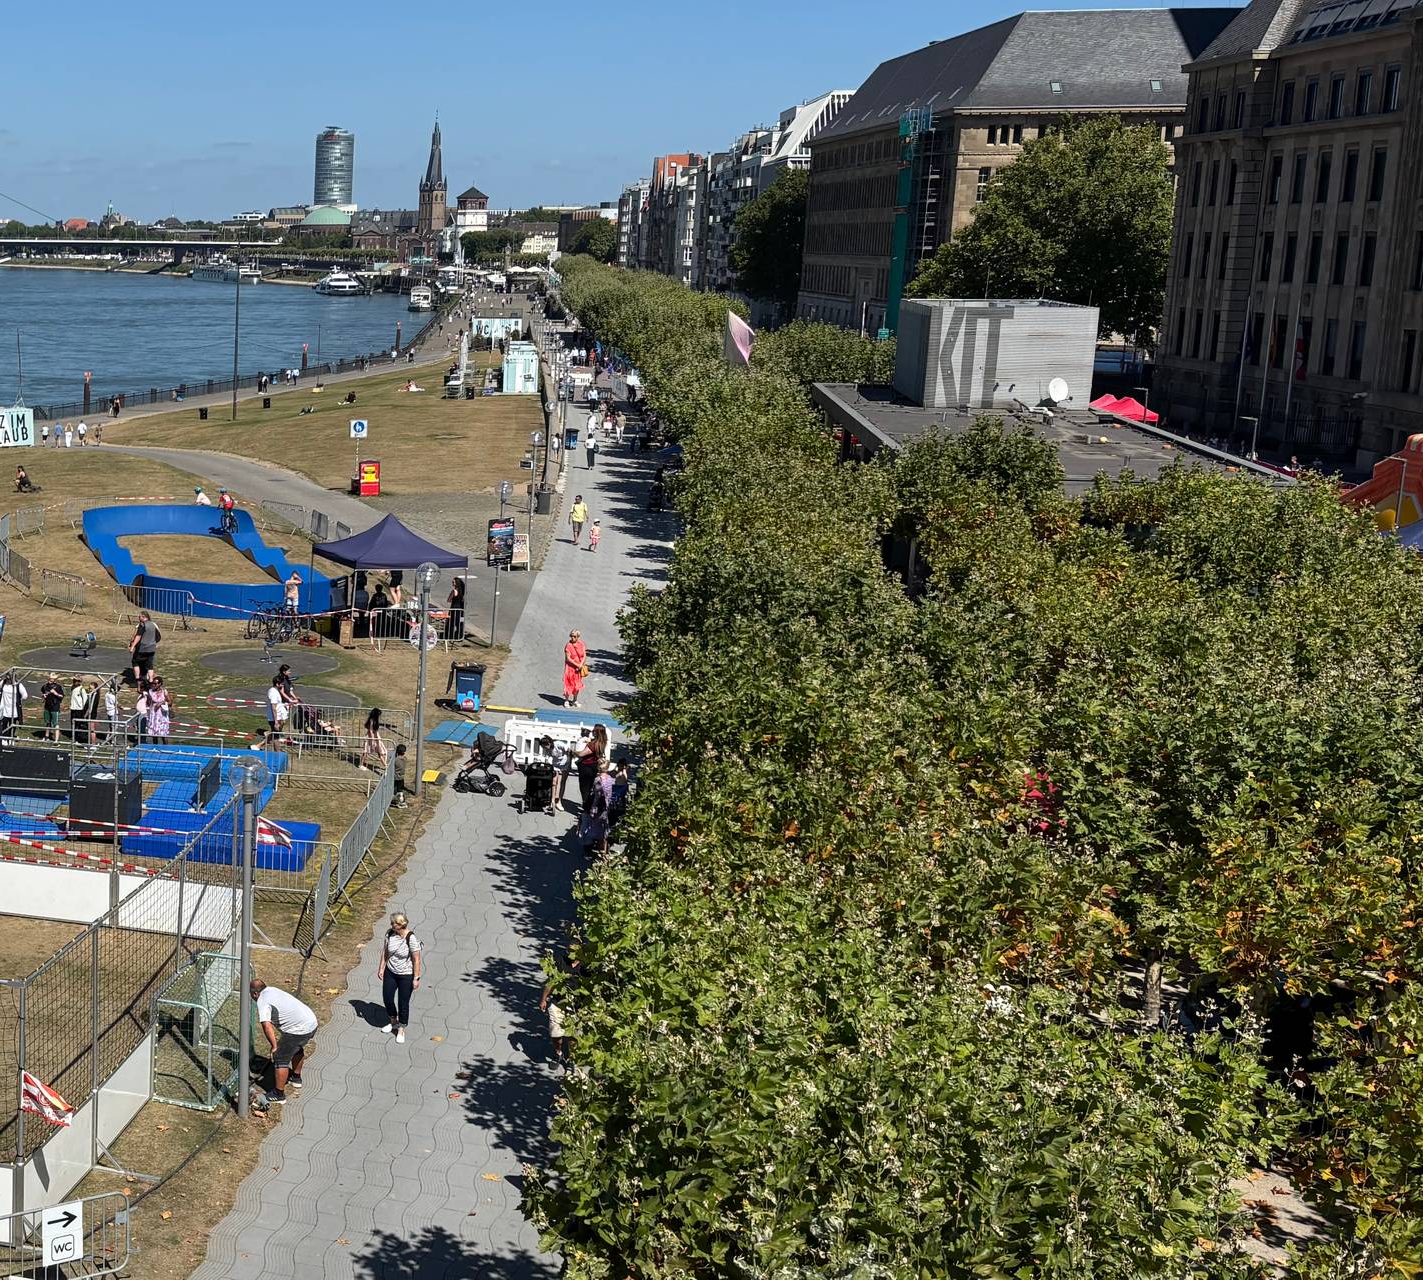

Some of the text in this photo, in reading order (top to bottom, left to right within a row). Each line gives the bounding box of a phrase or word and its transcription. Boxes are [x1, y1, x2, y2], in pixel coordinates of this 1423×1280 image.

[924, 306, 1015, 409] KIT
[11, 413, 25, 429] IM
[54, 1242, 73, 1254] WC
